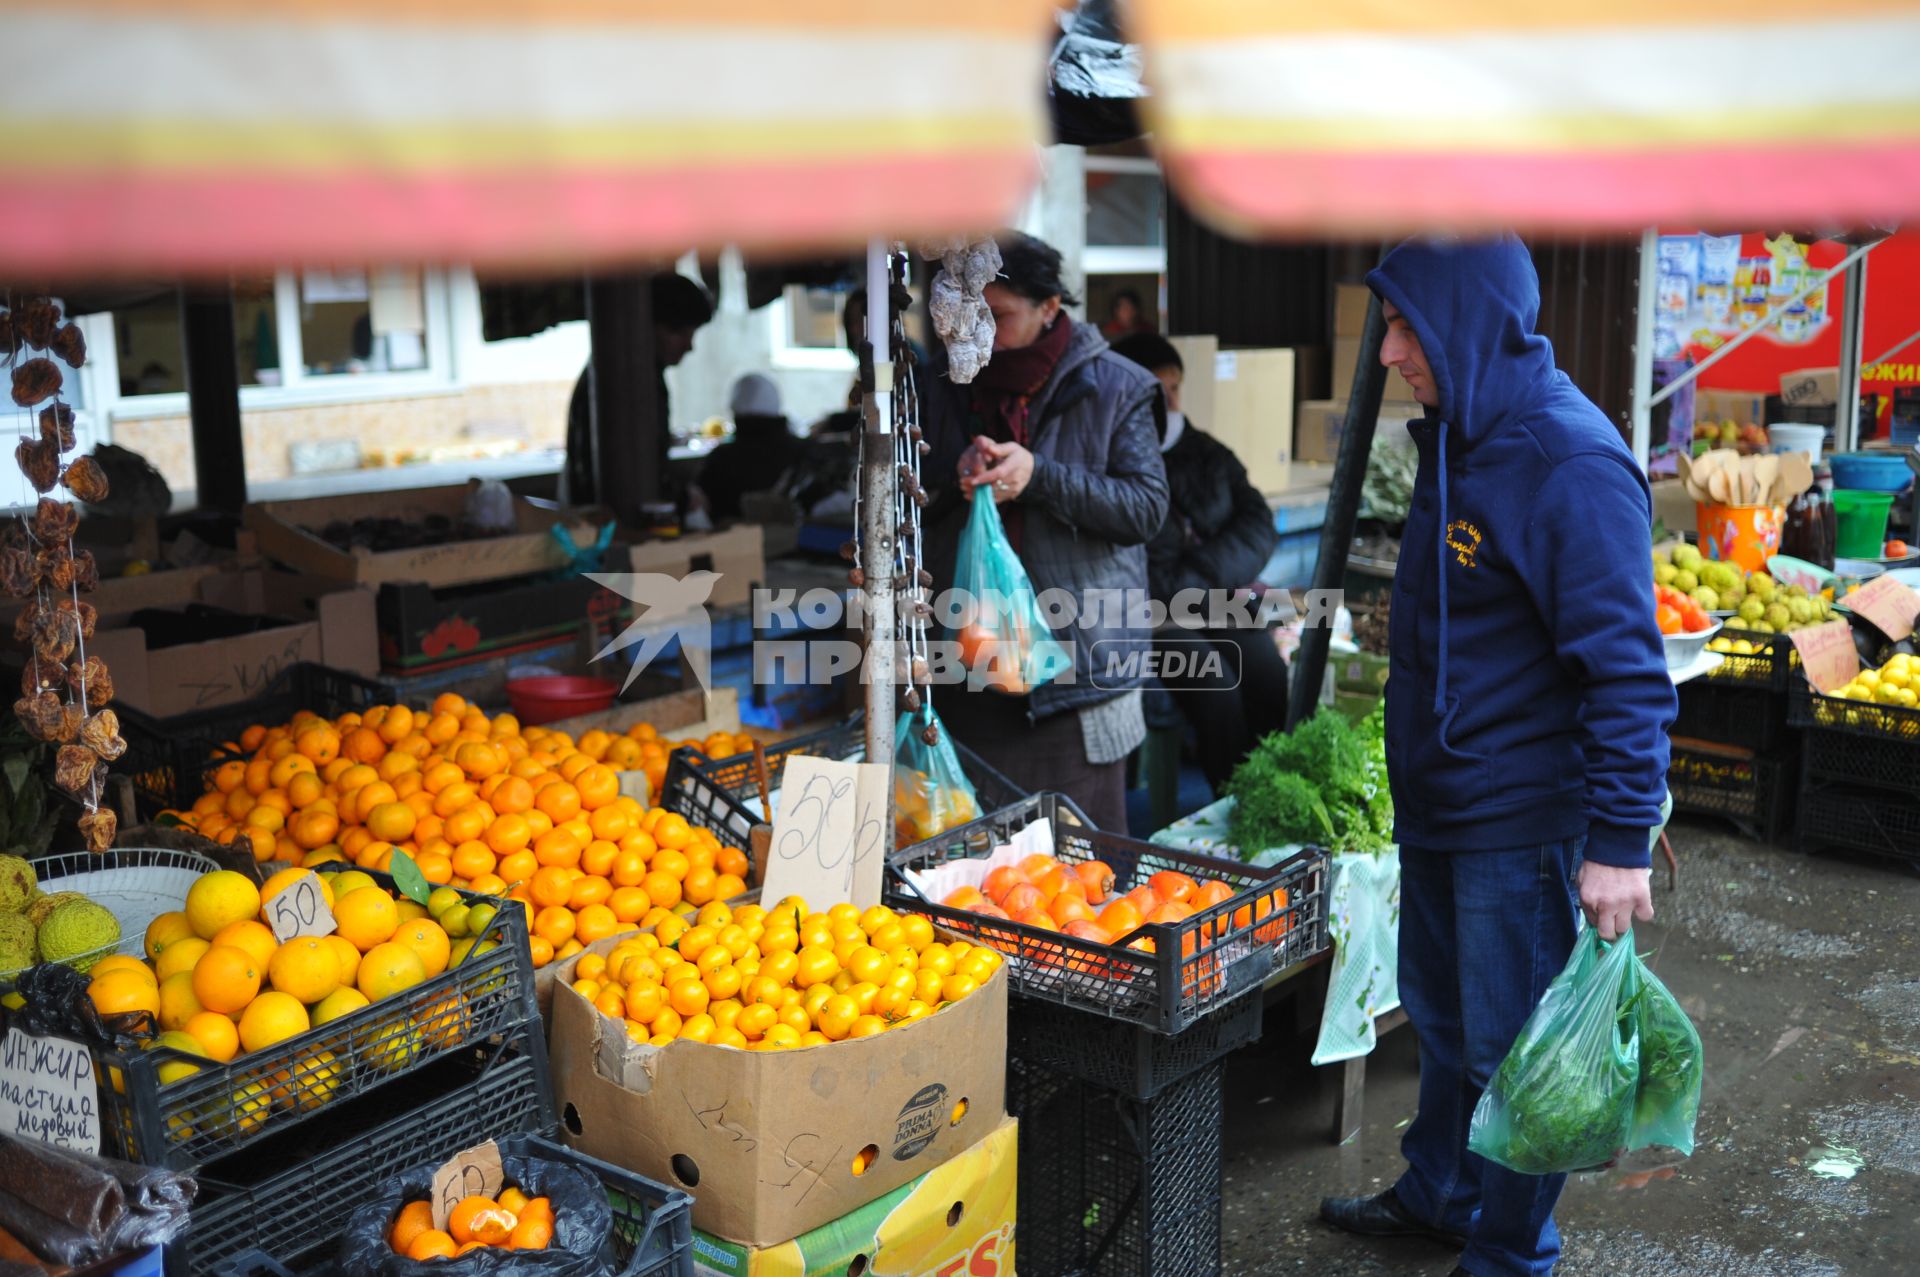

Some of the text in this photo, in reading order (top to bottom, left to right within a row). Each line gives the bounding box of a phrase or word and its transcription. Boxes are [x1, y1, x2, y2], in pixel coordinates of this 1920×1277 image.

[275, 882, 316, 941] 50
[893, 1120, 932, 1144] DONNA
[897, 1109, 933, 1133] PRIMA
